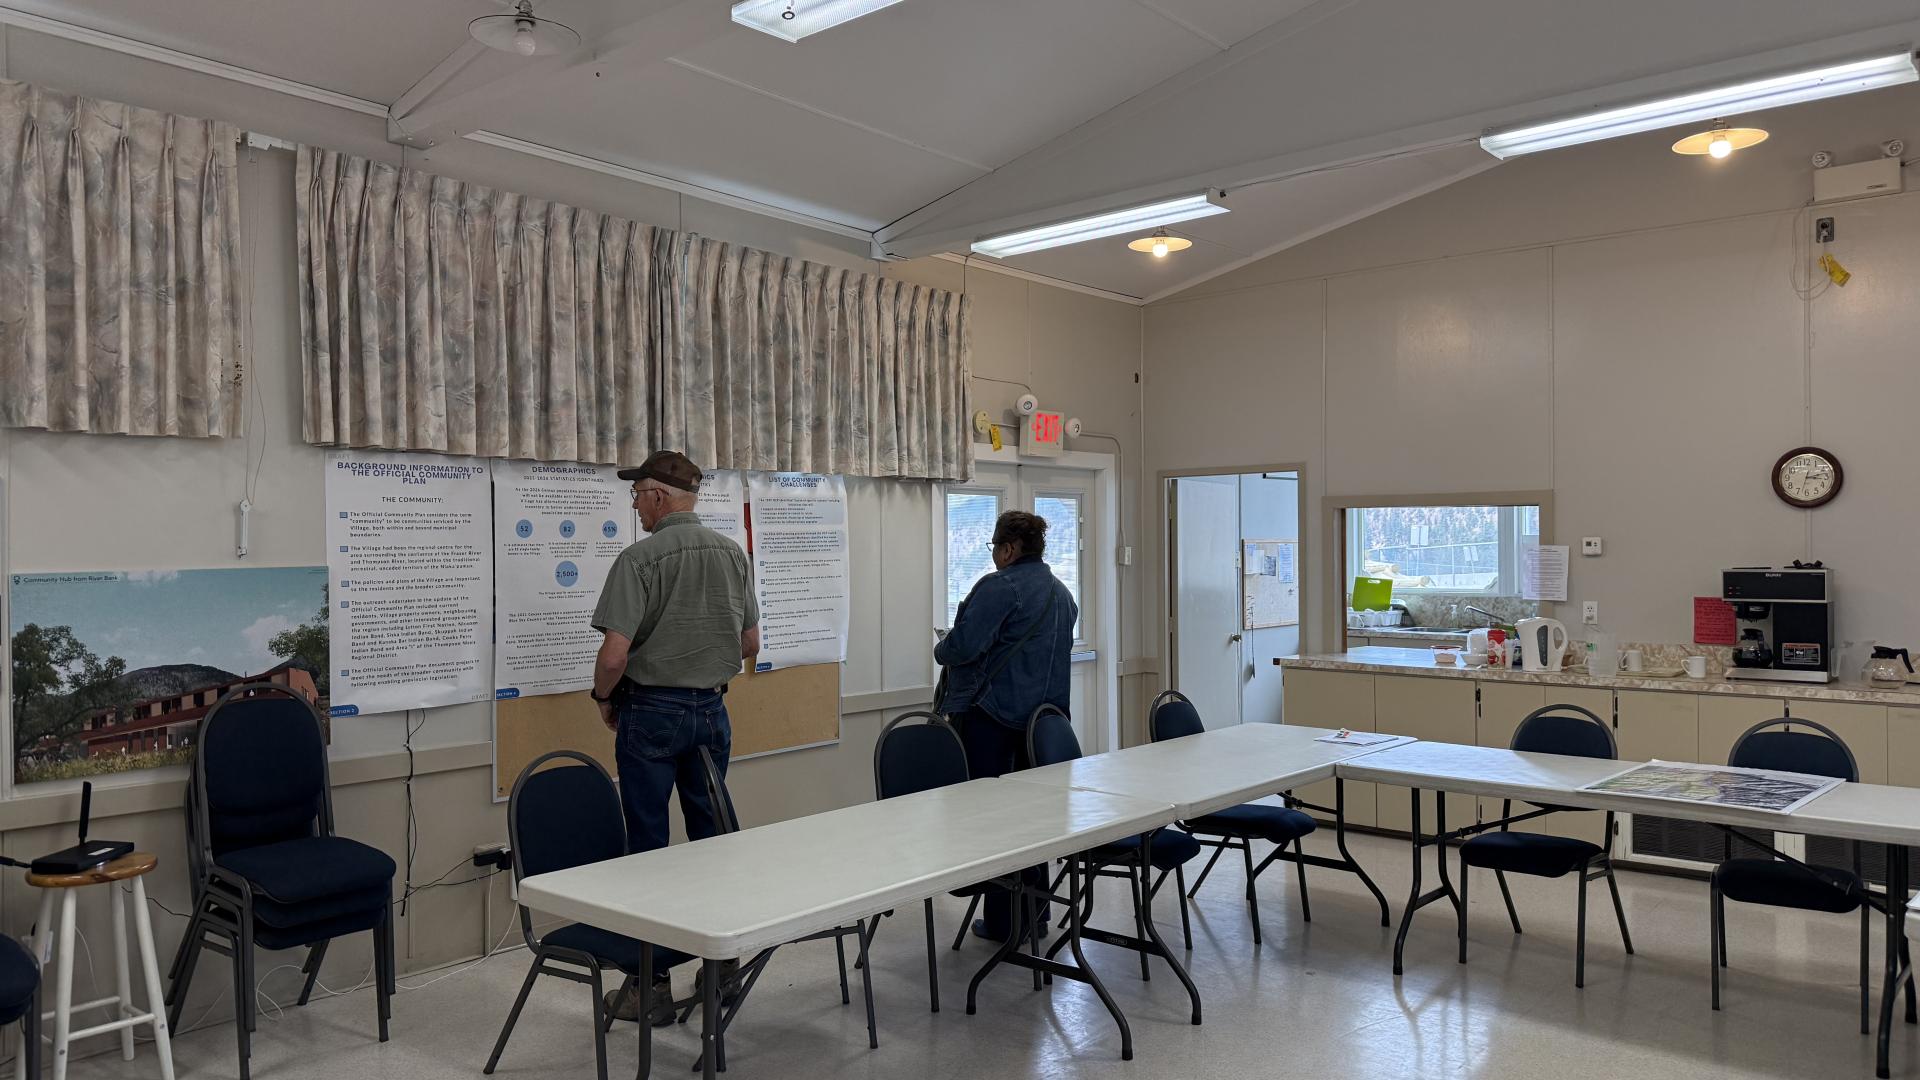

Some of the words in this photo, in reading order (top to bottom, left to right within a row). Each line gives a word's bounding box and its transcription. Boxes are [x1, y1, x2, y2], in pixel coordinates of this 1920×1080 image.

[1035, 413, 1059, 442] EXIT
[337, 462, 406, 471] BACKGROUND
[409, 464, 470, 473] INFORMATION
[532, 466, 596, 475] DEMOGRAPHICS
[1789, 466, 1796, 474] 10
[373, 470, 416, 478] OFFICIAL
[418, 471, 471, 480] COMMUNITY
